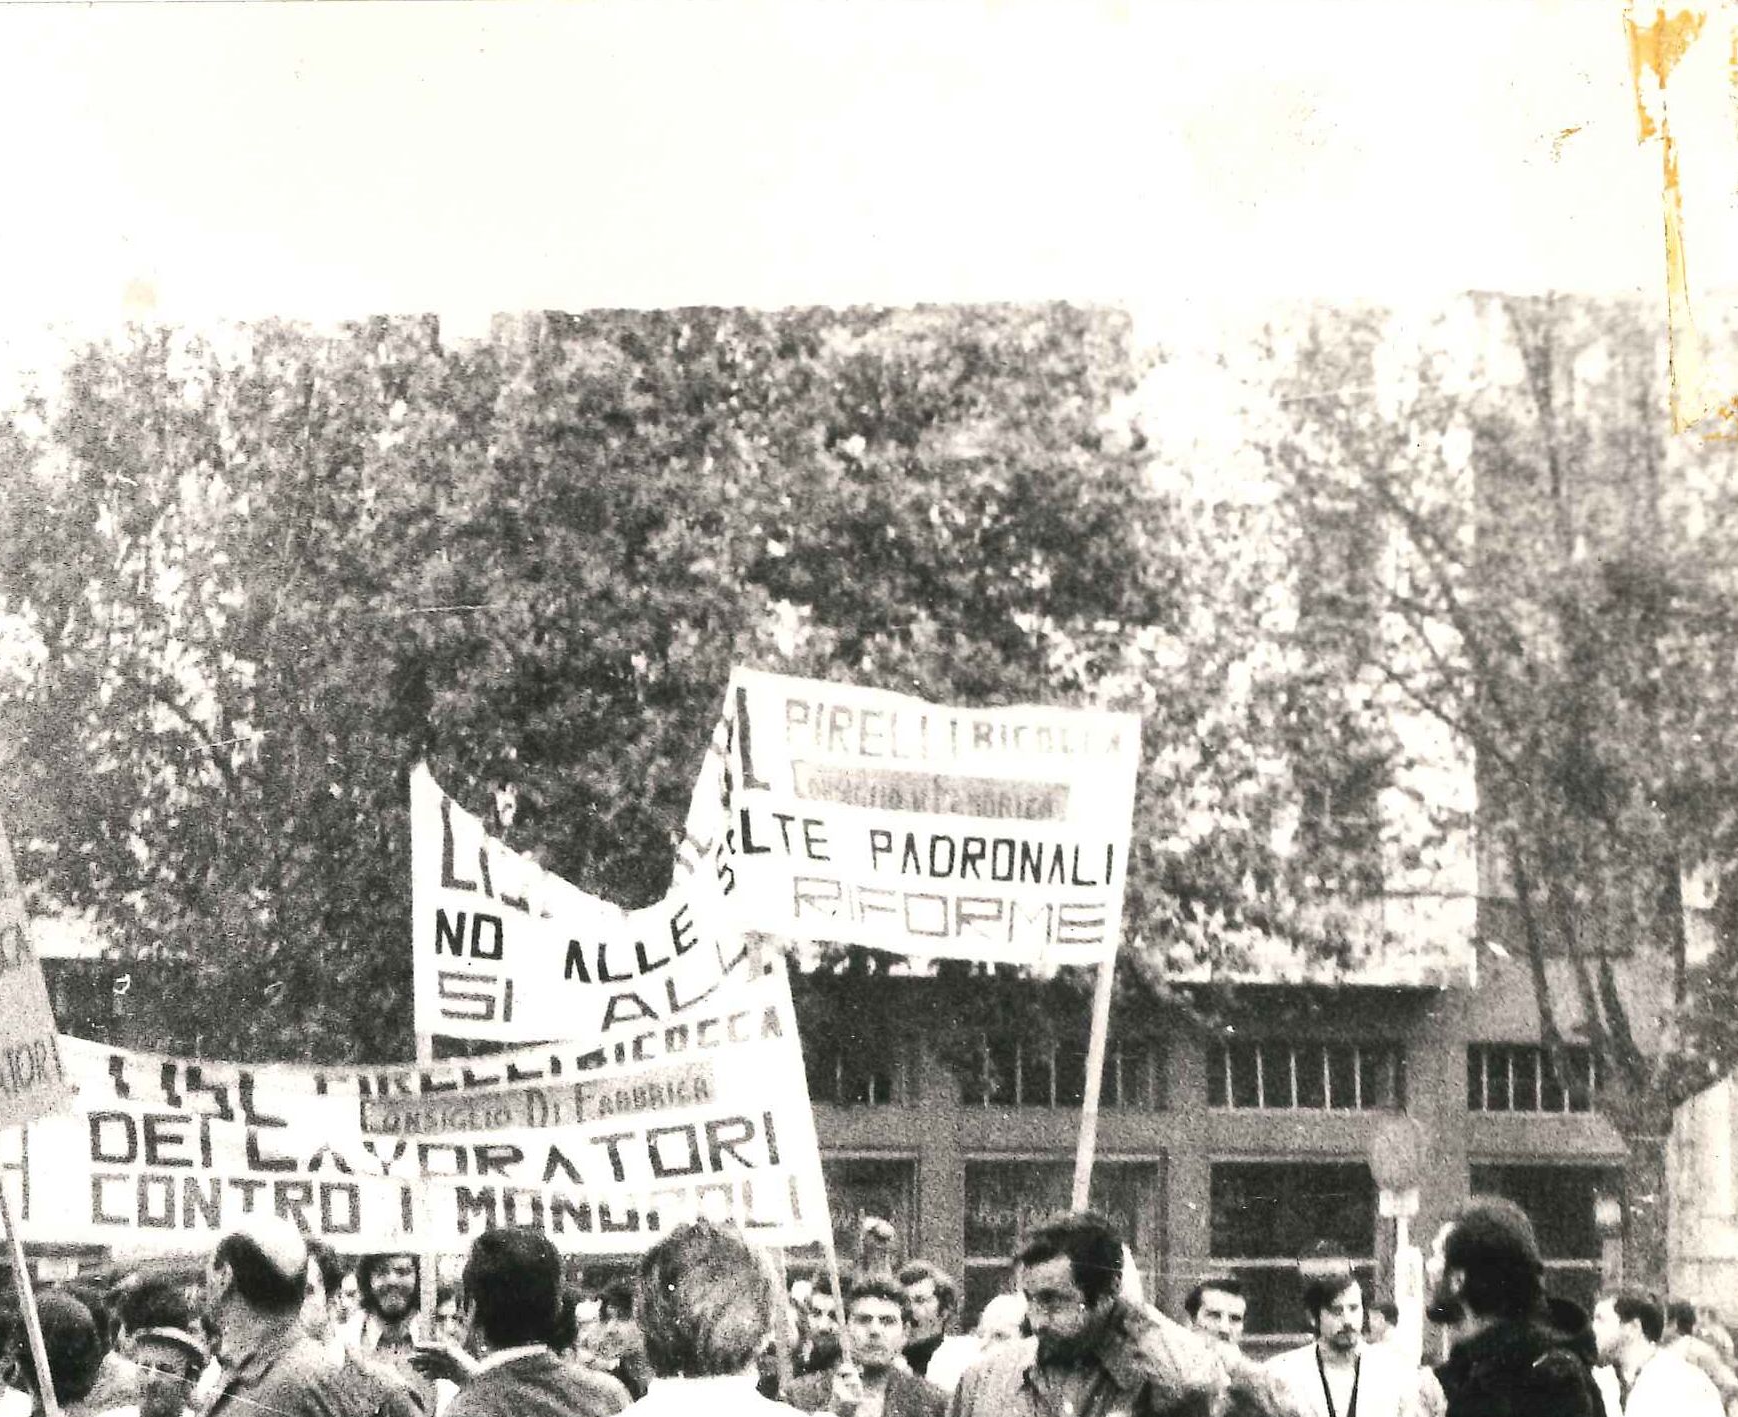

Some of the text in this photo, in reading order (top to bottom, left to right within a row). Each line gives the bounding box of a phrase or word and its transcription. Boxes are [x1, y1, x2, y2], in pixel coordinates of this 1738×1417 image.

[434, 907, 504, 961] NO
[564, 902, 699, 984] ALLE
[870, 828, 1114, 887] PADRONALI
[437, 970, 514, 1023] SI
[792, 875, 1106, 946] RIFORME
[91, 1172, 361, 1234] CONTRO
[400, 1185, 414, 1234] I
[245, 1108, 780, 1186] LAVORATORI
